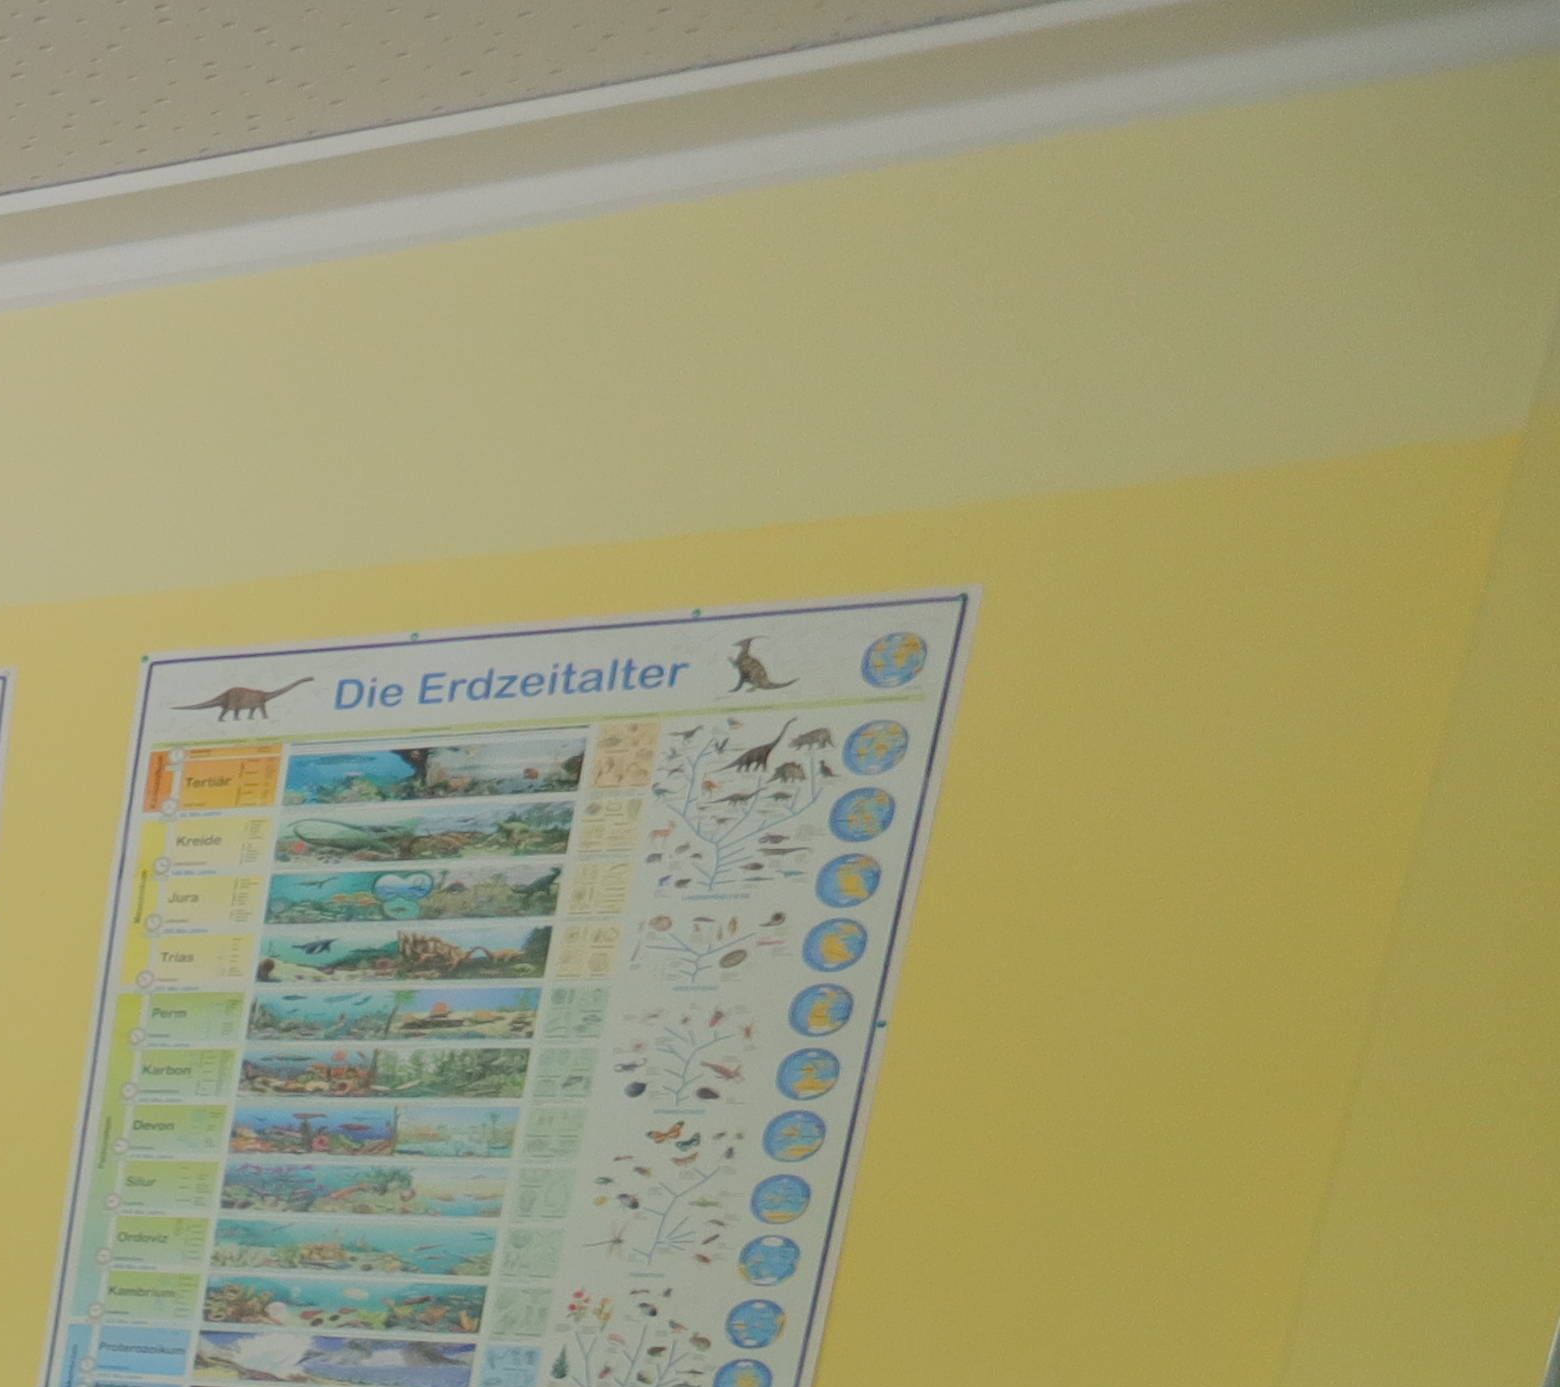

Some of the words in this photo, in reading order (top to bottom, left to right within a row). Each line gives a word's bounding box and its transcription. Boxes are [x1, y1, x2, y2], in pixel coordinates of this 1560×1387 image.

[334, 677, 404, 710] Die
[417, 658, 690, 704] Erdzeitalter
[176, 835, 222, 847] Kreide
[168, 892, 199, 904] Jura
[161, 951, 195, 963] Trias
[151, 1007, 188, 1019] Perm
[142, 1064, 192, 1076] Karbon
[132, 1119, 176, 1131] Devon
